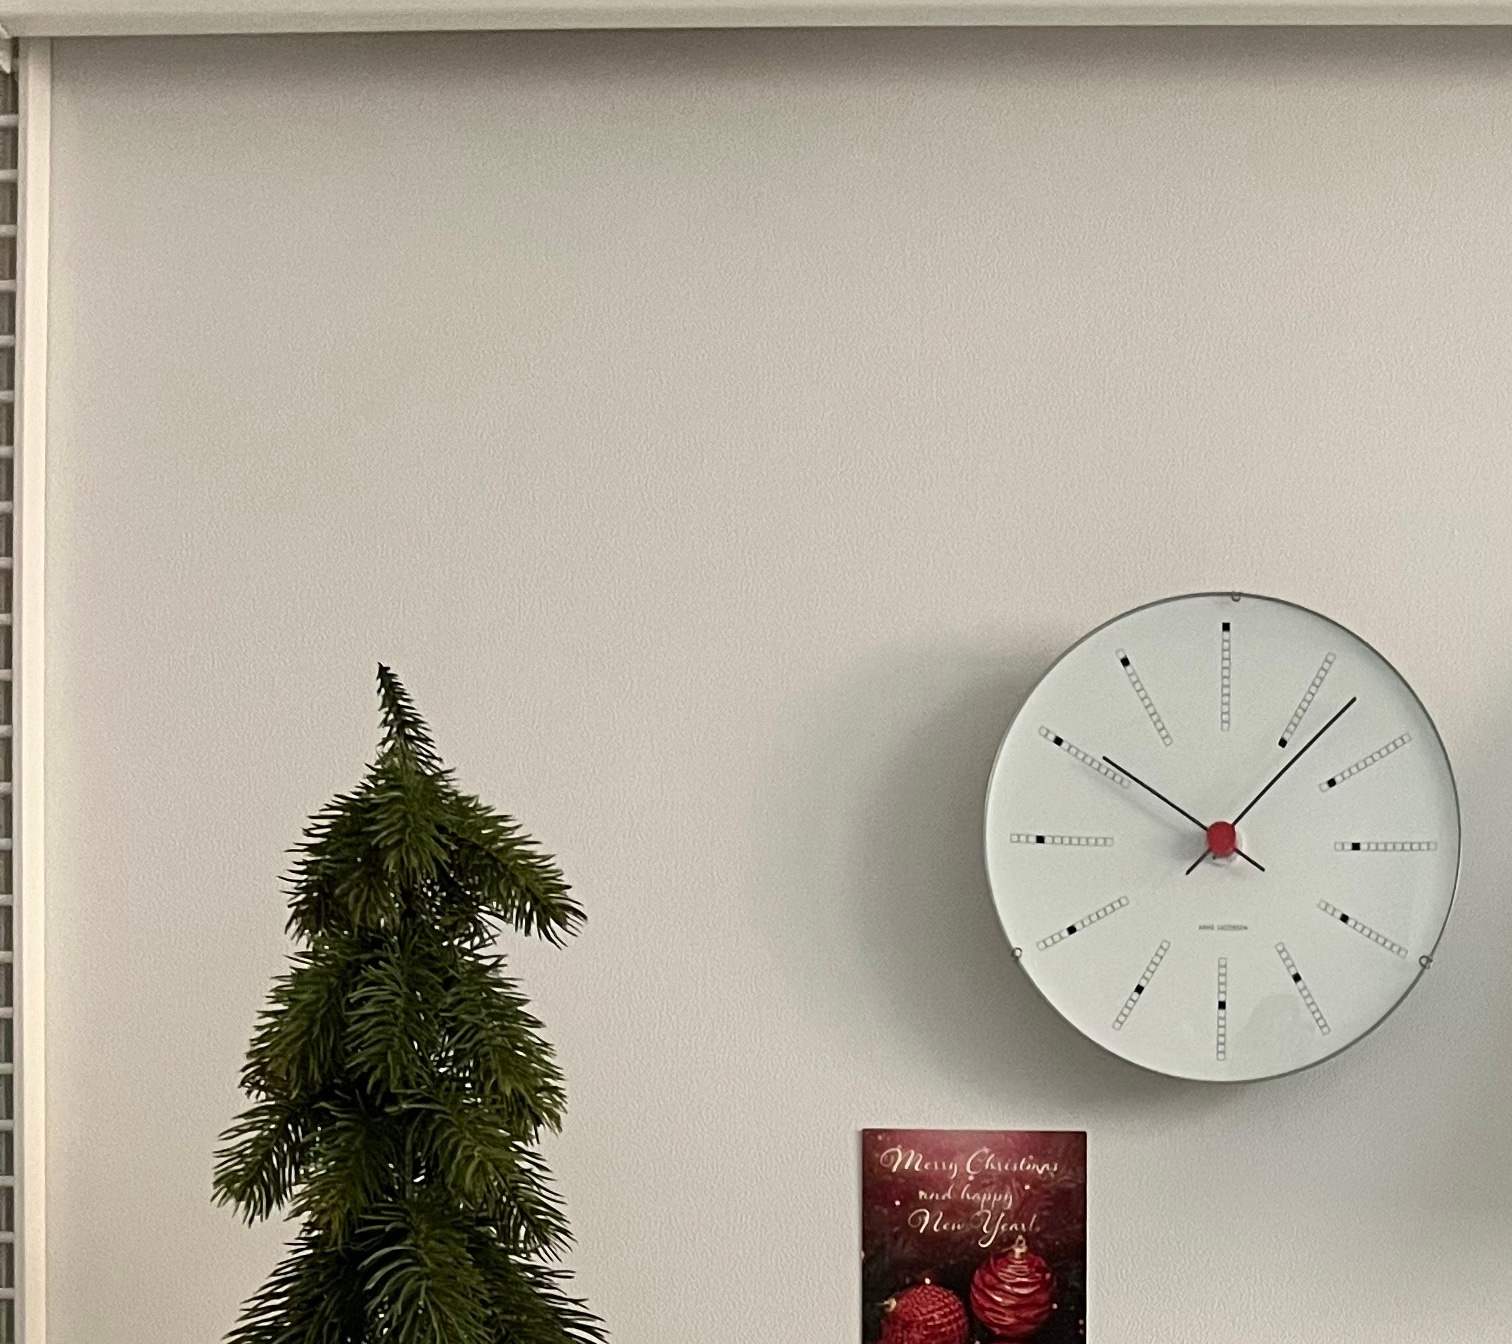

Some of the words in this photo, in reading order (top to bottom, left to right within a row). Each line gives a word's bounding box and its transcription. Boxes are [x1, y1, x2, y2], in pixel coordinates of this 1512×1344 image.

[880, 1146, 958, 1180] Merry
[965, 1146, 1059, 1175] Christmas
[918, 1183, 954, 1201] and
[960, 1183, 1014, 1210] happy
[907, 1208, 964, 1235] New
